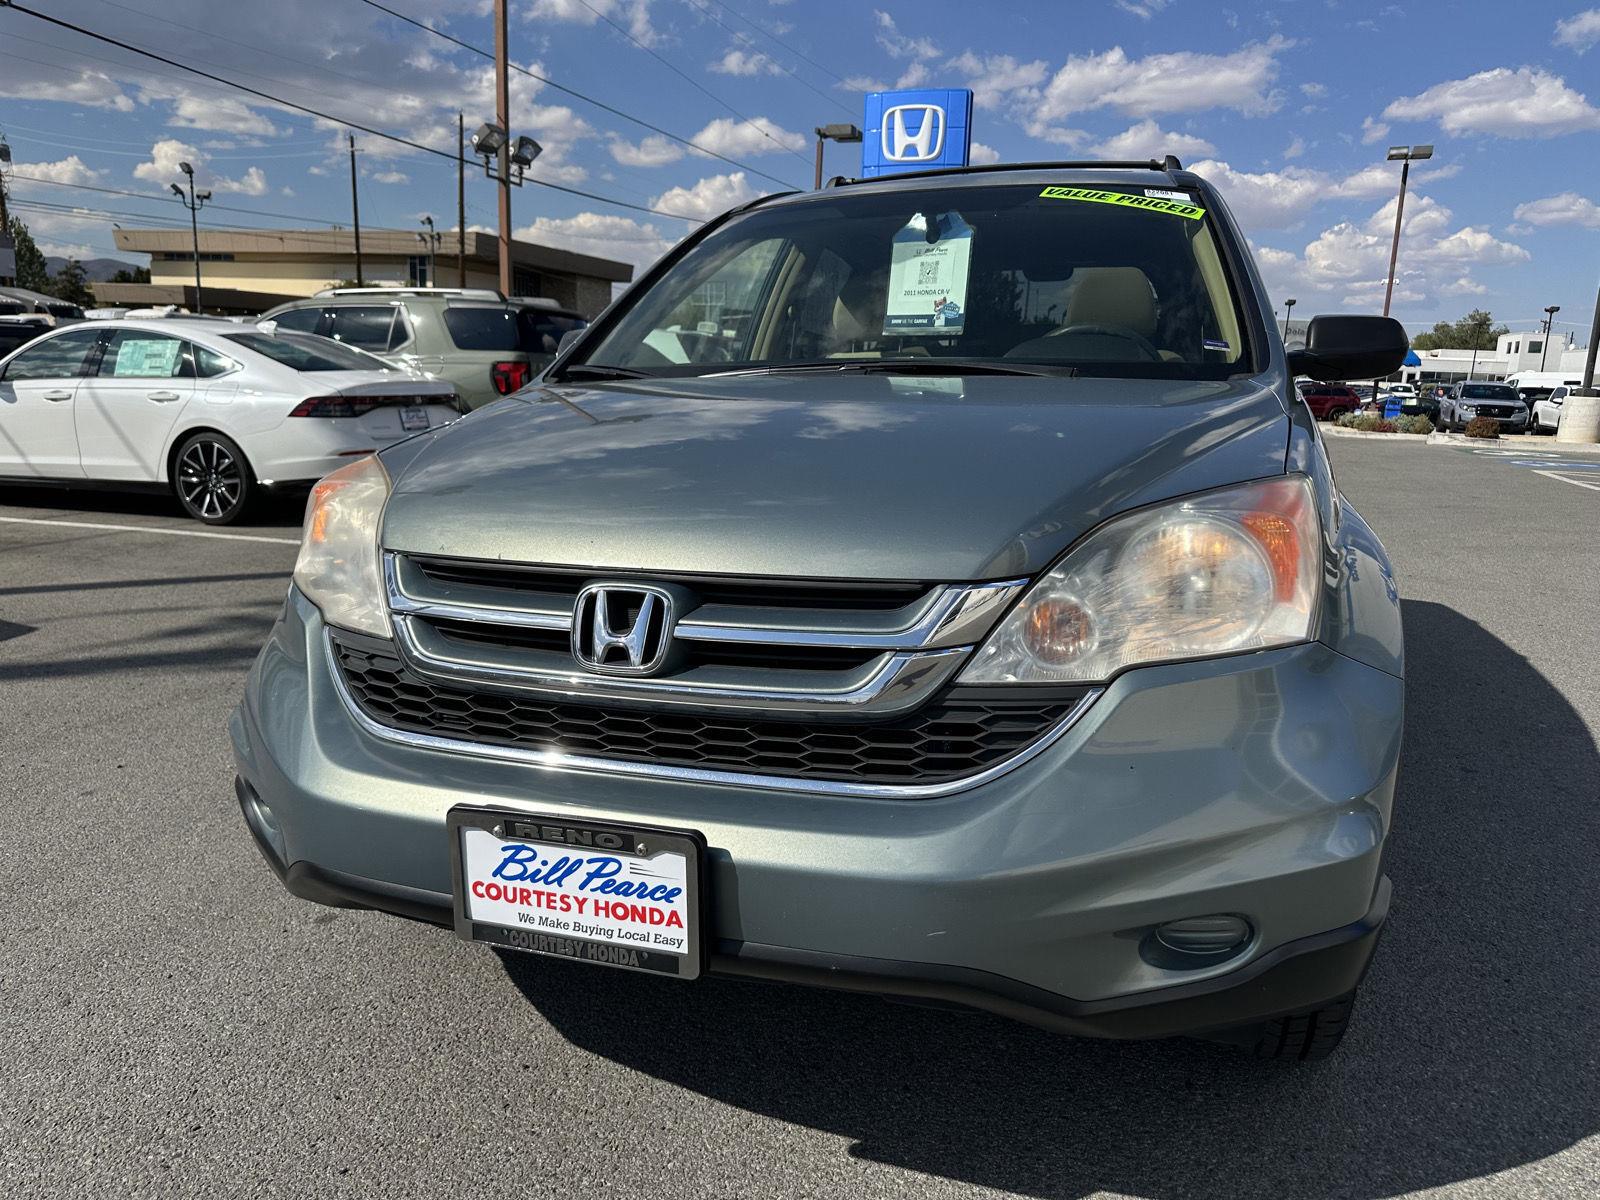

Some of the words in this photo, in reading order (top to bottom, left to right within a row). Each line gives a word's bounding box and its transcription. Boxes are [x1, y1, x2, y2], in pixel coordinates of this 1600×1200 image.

[1046, 188, 1111, 200] VALUE
[1115, 195, 1198, 215] PRICED
[515, 823, 624, 849] RENO
[492, 844, 584, 888] Bill
[579, 857, 683, 904] Pearce
[472, 880, 589, 915] COURTESY
[594, 899, 684, 929] HONDA
[518, 912, 536, 925] We
[538, 915, 570, 931] Make
[573, 920, 614, 939] Buying
[617, 928, 650, 943] Local
[653, 933, 684, 948] Easy
[509, 930, 586, 958] COURTESY
[588, 943, 640, 968] HONDA
